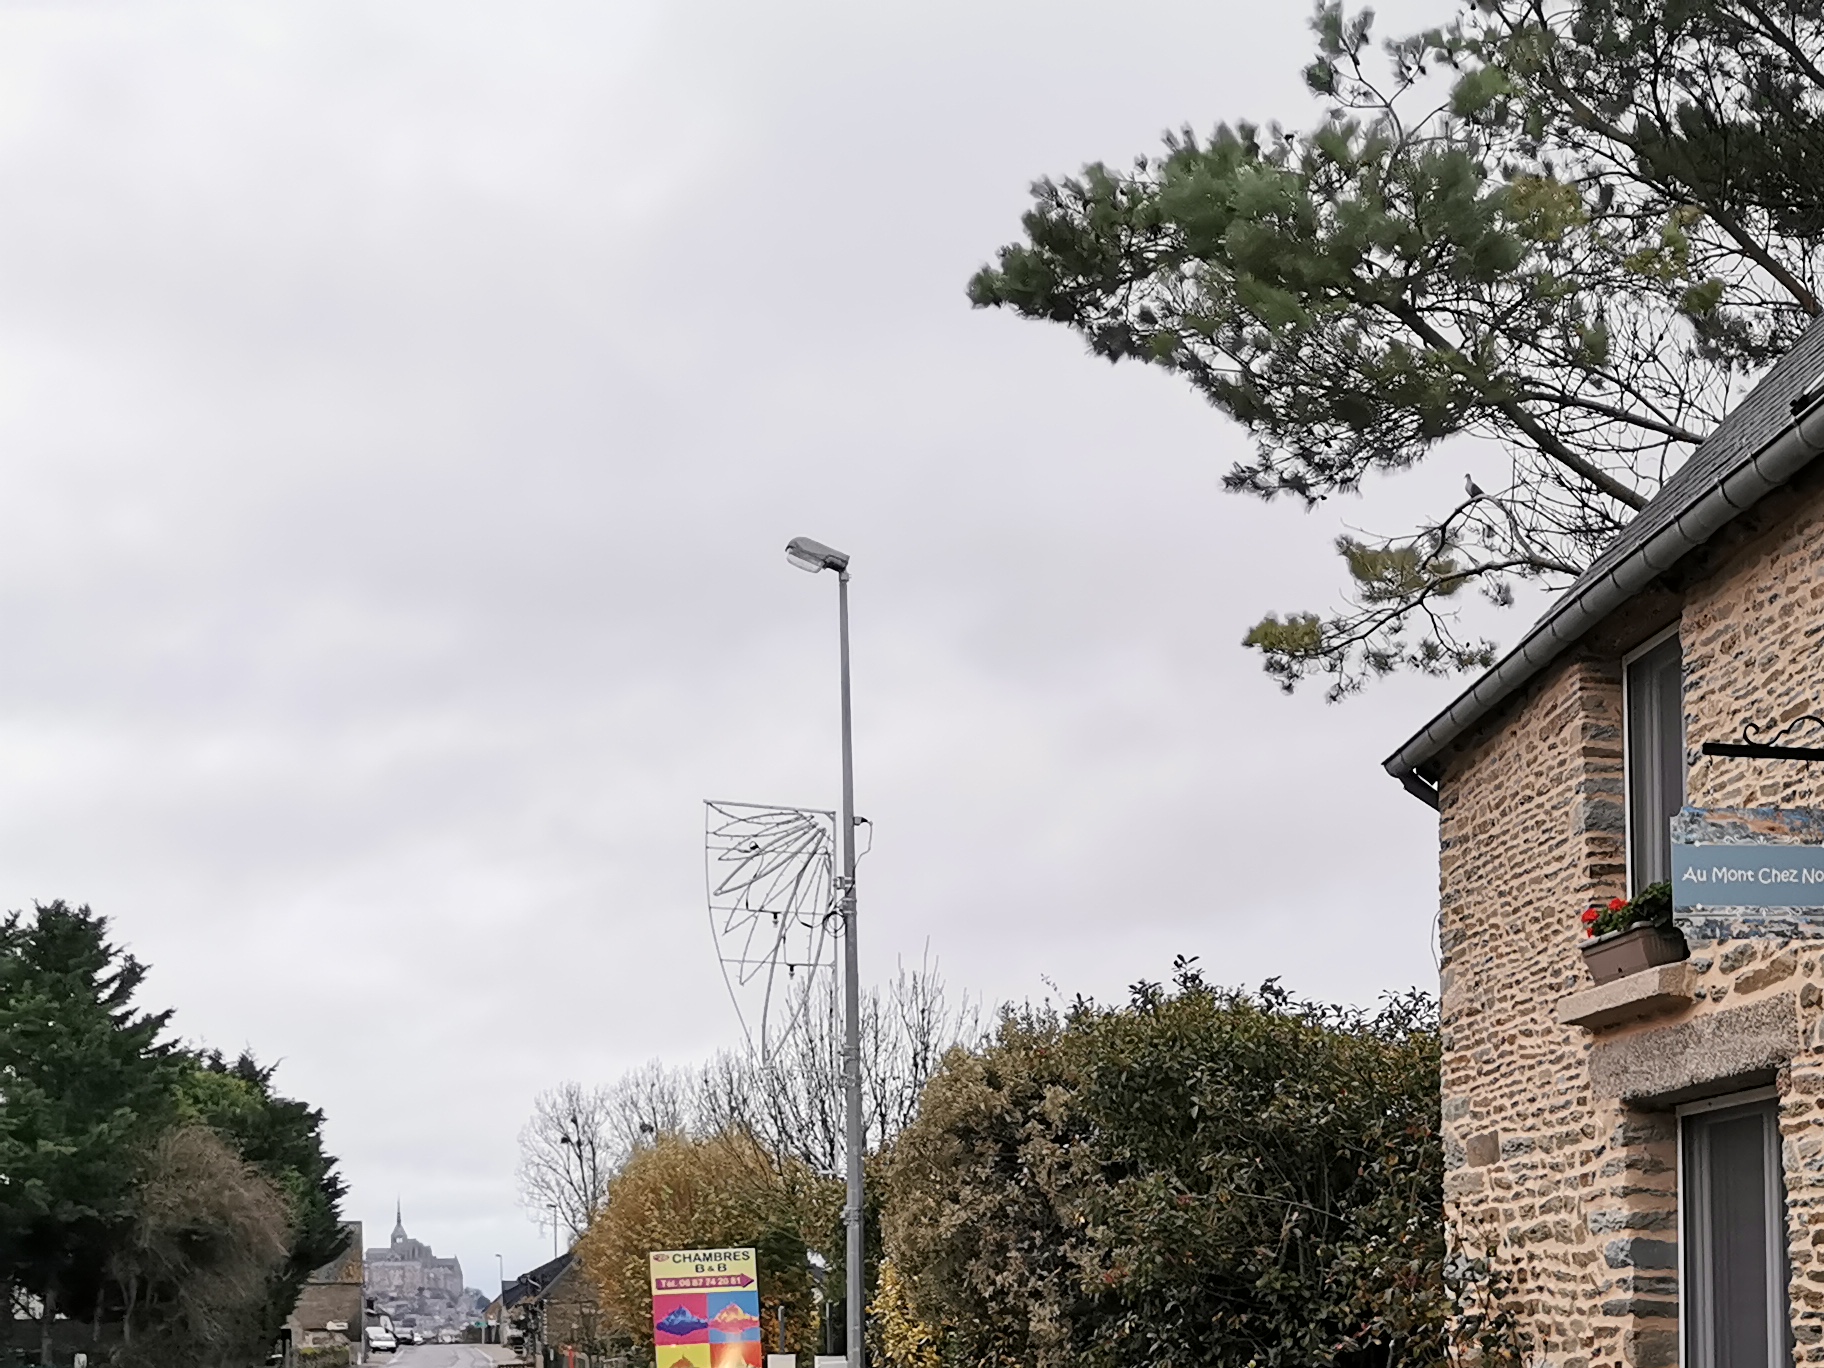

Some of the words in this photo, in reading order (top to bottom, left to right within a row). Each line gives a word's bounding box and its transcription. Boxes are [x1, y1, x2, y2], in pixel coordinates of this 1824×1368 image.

[1682, 866, 1707, 883] Au
[1712, 867, 1755, 884] Mont
[1758, 867, 1799, 884] Chez
[672, 1251, 750, 1263] CHAMBRES
[695, 1264, 705, 1273] B
[717, 1263, 727, 1272] B
